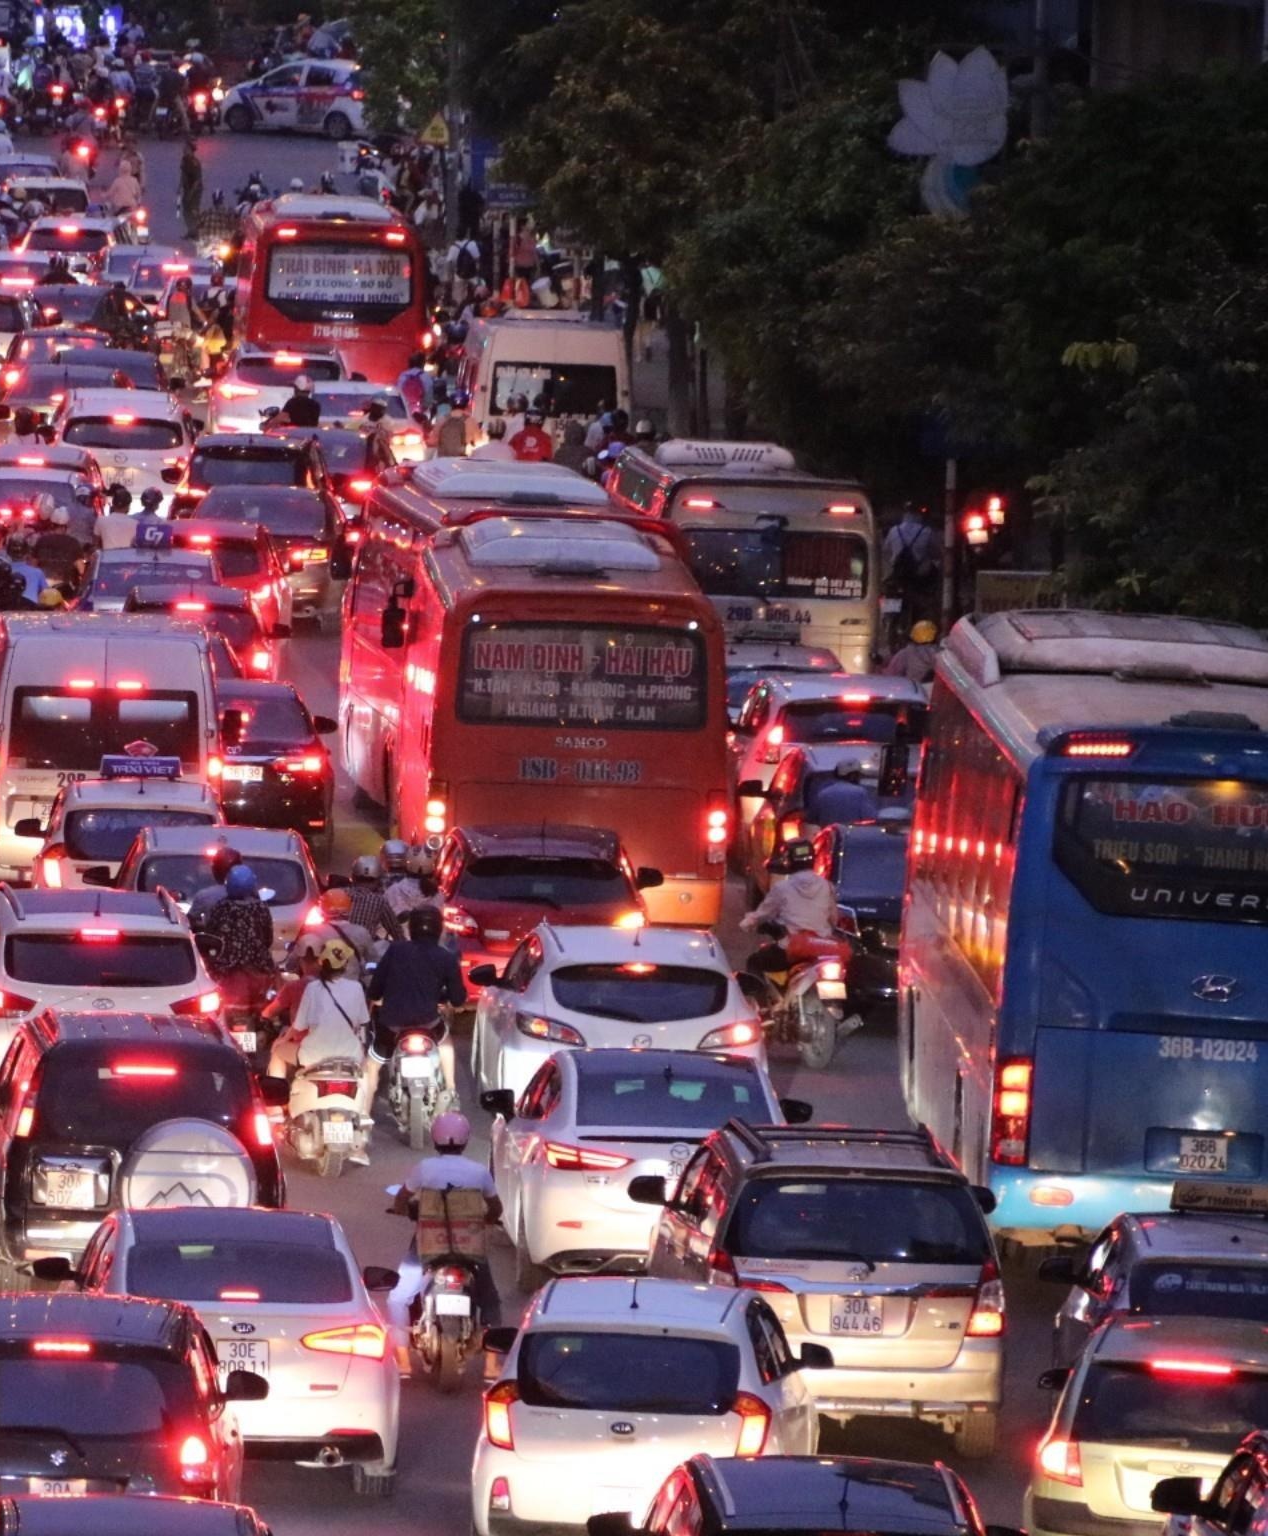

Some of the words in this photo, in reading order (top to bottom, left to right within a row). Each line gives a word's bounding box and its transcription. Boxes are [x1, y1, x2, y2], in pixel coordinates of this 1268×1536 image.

[474, 641, 525, 671] NAM
[555, 737, 607, 749] SAMCO
[1130, 887, 1268, 910] UNIVER
[1158, 1036, 1259, 1063] 36B-02024
[1191, 1139, 1217, 1154] 36B
[843, 1299, 871, 1315] 30A
[229, 1342, 257, 1359] 30E
